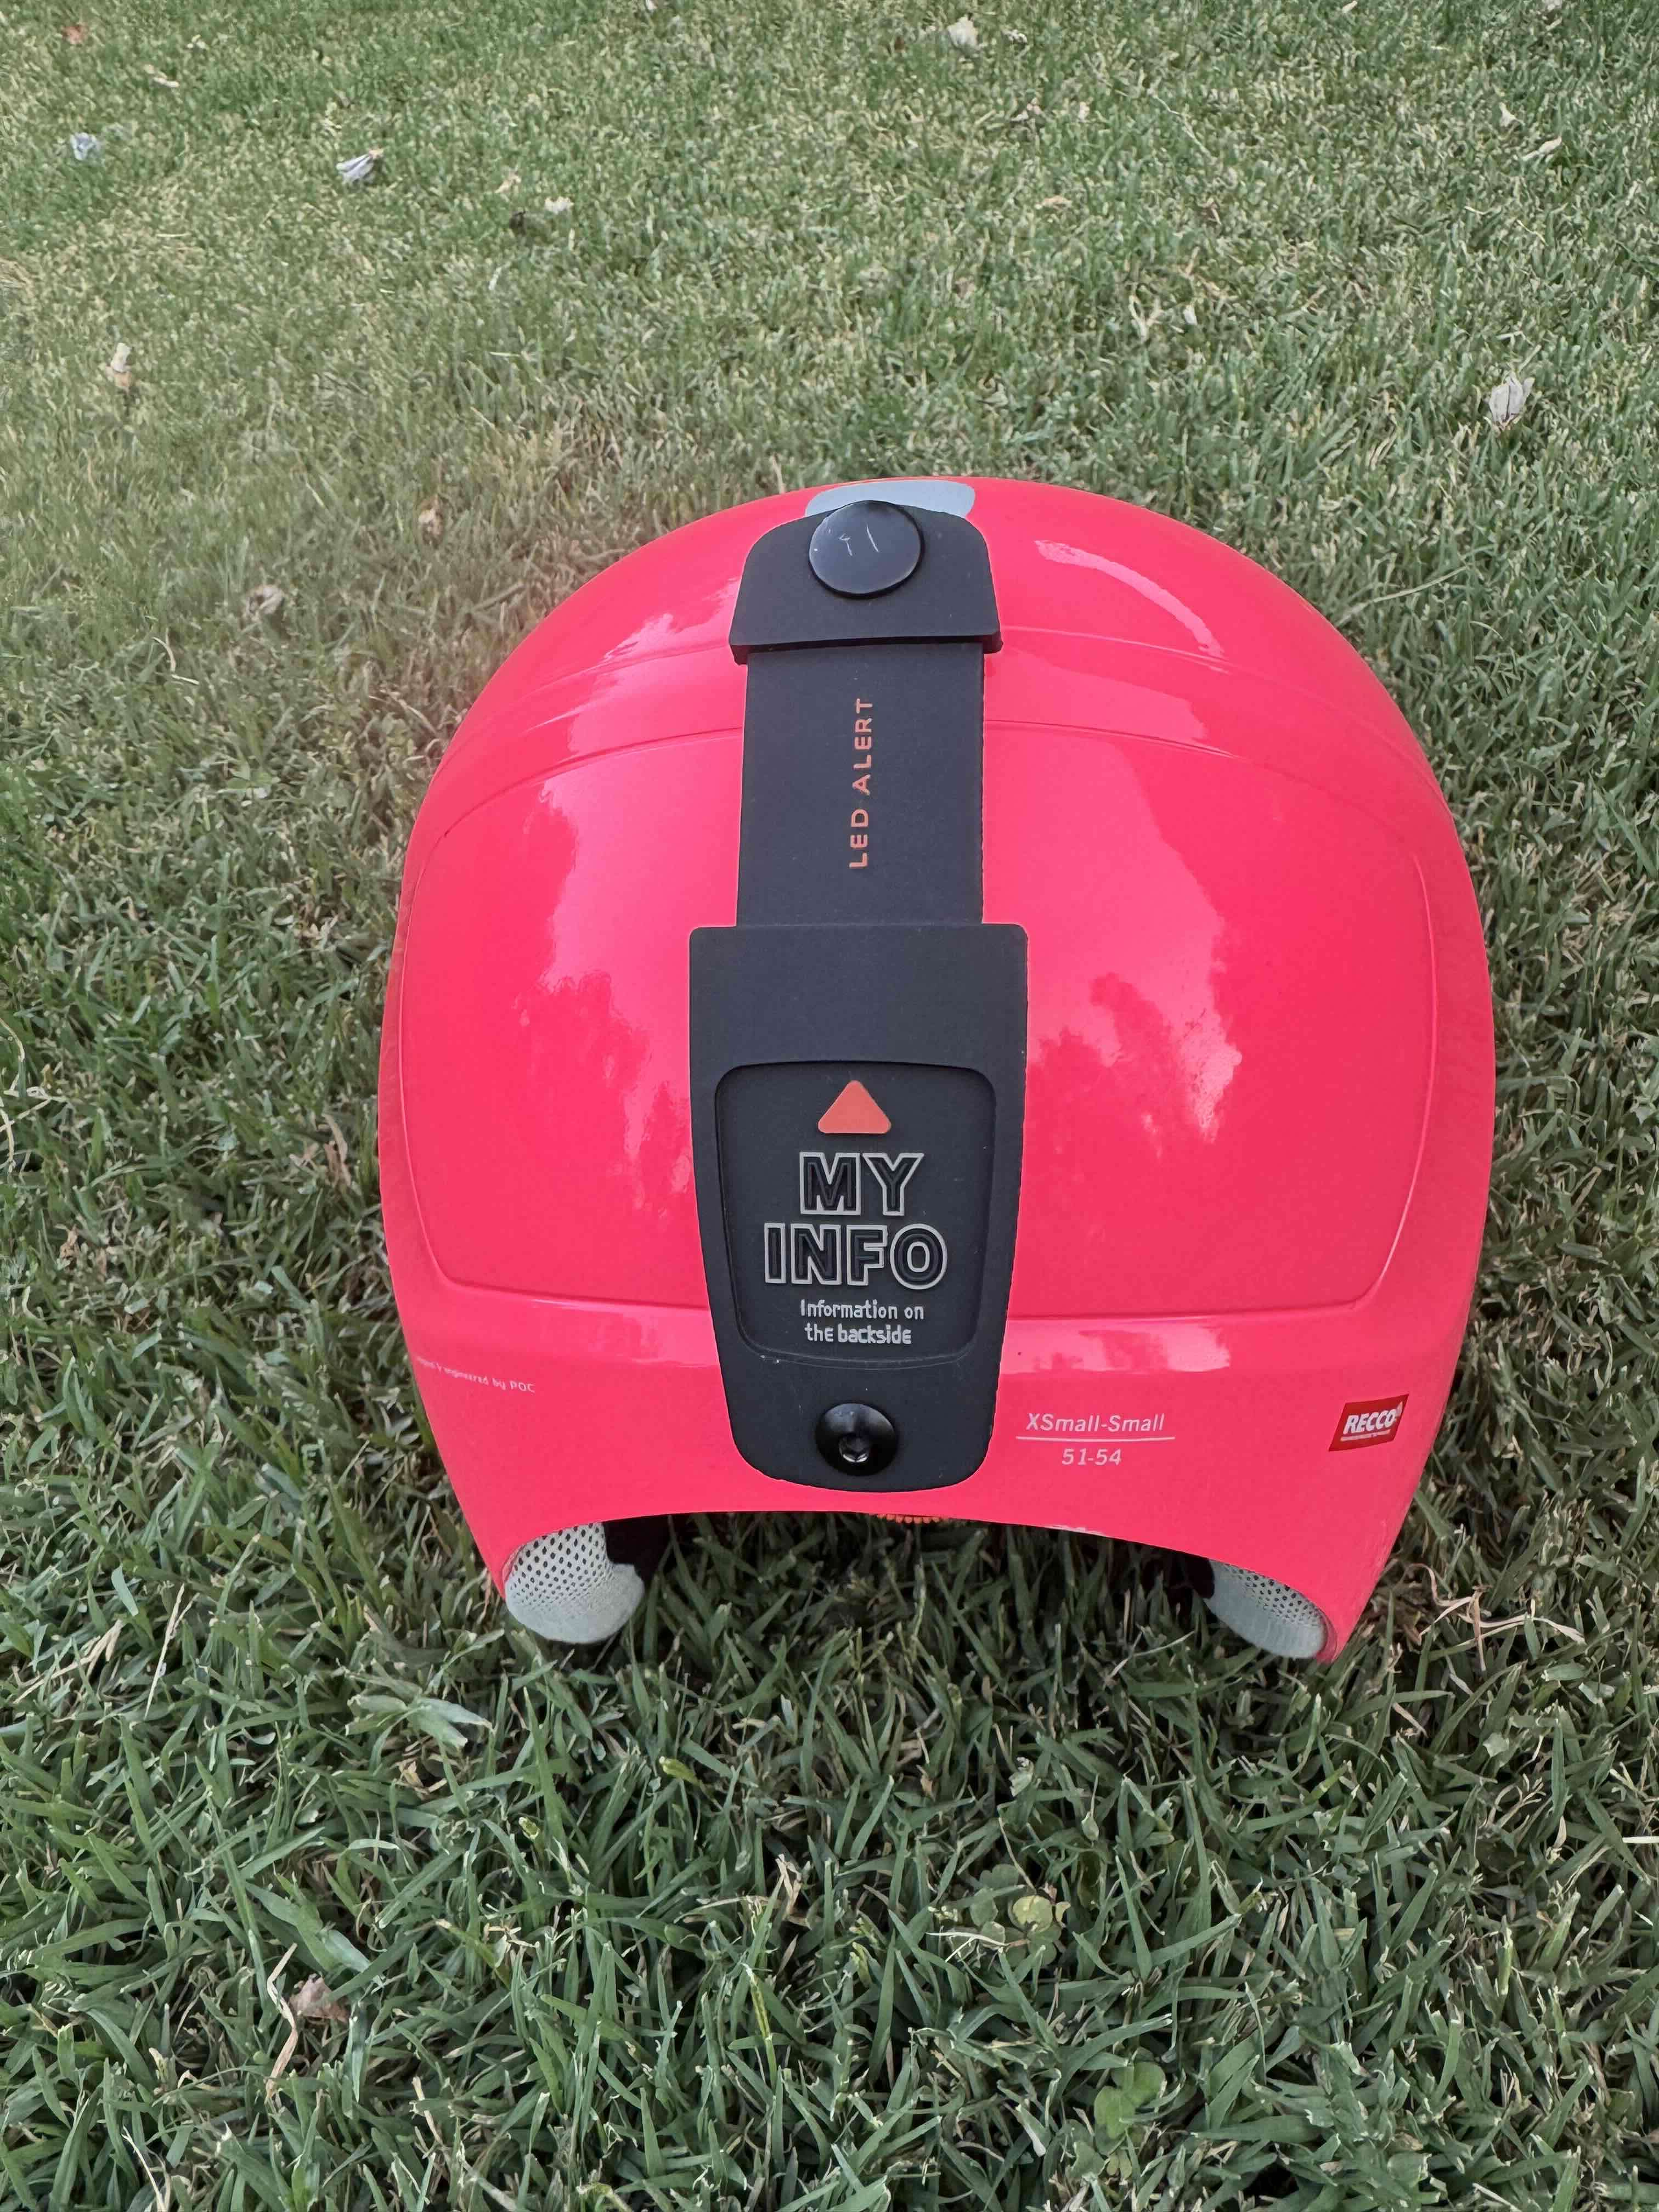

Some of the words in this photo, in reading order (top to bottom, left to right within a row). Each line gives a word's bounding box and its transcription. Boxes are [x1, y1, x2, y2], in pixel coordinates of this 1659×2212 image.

[851, 698, 873, 796] ALERT
[849, 808, 870, 869] LED
[799, 1152, 924, 1216] MY
[764, 1222, 948, 1290] INFO
[800, 1299, 898, 1319] Information
[904, 1305, 924, 1319] on
[804, 1322, 834, 1342] the
[837, 1323, 912, 1345] backside
[492, 1377, 506, 1391] by
[509, 1380, 535, 1393] POC
[1025, 1413, 1165, 1432] XSmall-Small
[1342, 1408, 1397, 1435] RECCO
[1062, 1448, 1122, 1466] 51-54
